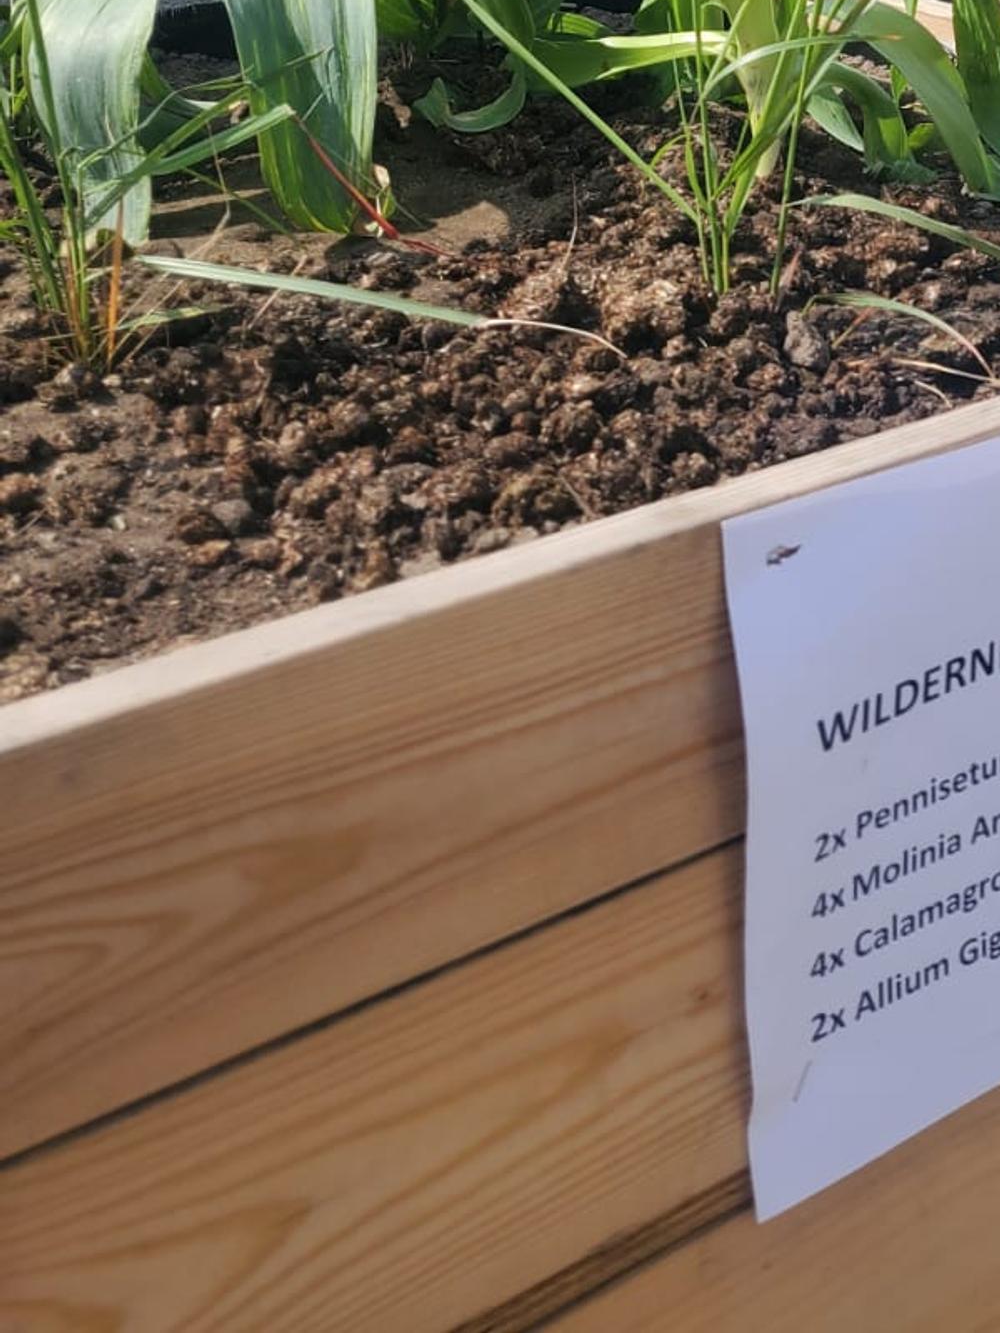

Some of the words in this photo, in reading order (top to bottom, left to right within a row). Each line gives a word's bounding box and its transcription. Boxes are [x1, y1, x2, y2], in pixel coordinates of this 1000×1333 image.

[815, 829, 846, 862] 2x
[812, 888, 844, 917] 4x
[853, 834, 961, 900] Molinia
[811, 949, 844, 976] 4x
[812, 1009, 845, 1042] 2x
[855, 958, 949, 1020] Allium
